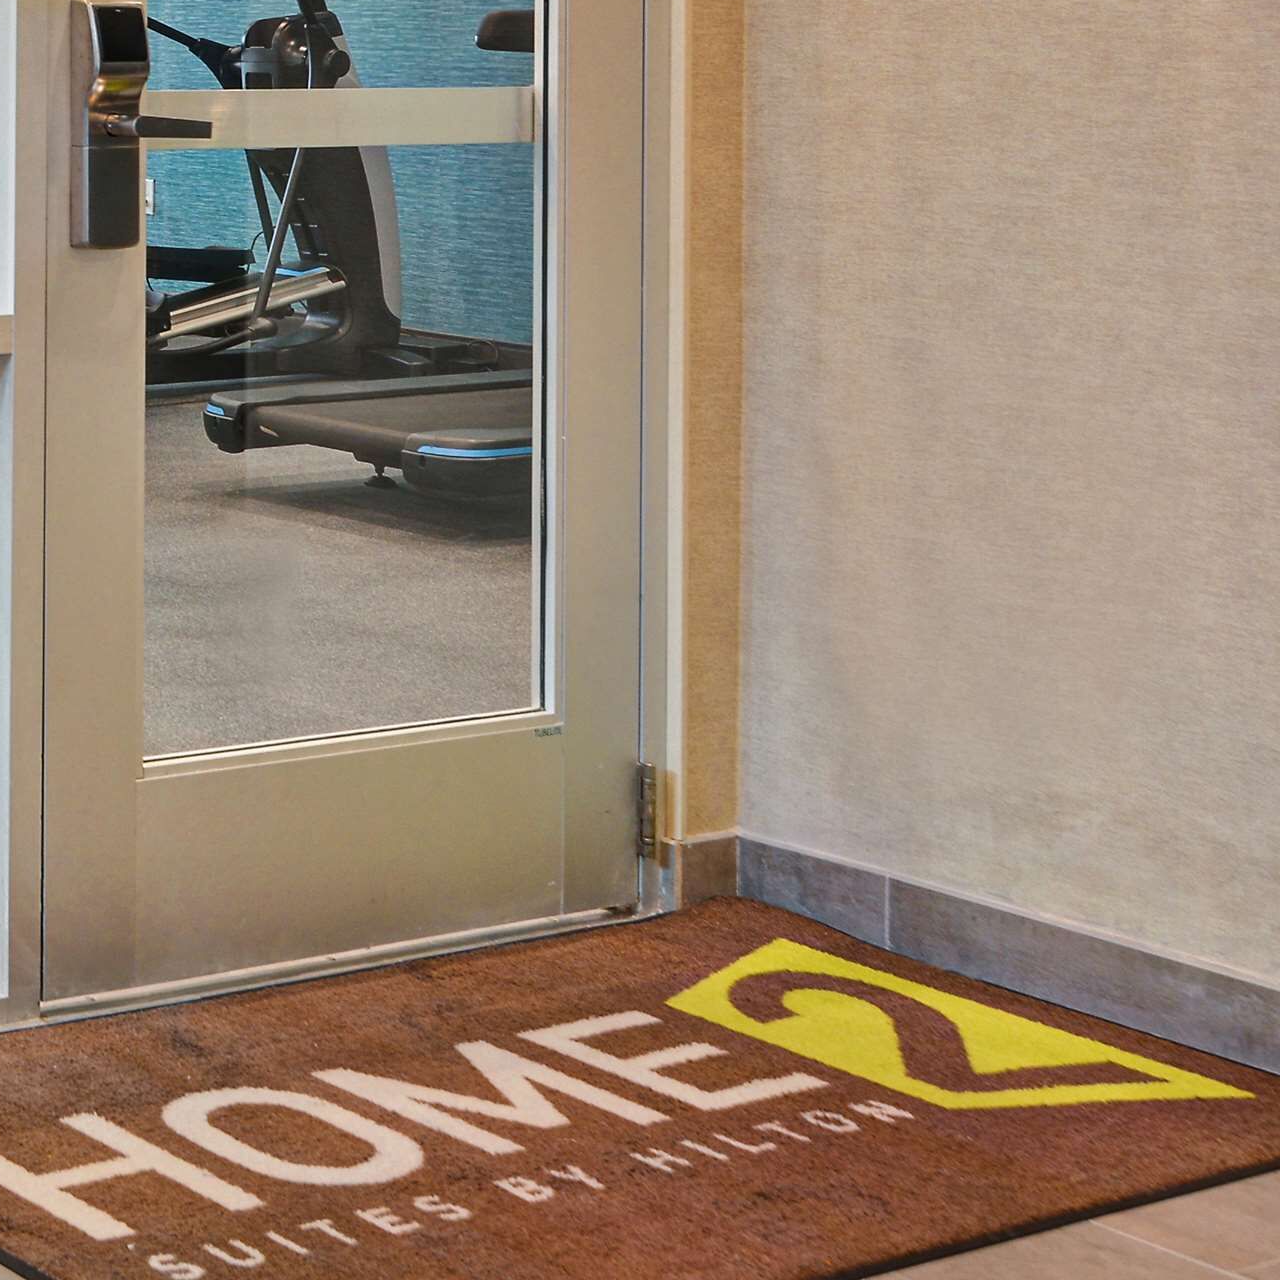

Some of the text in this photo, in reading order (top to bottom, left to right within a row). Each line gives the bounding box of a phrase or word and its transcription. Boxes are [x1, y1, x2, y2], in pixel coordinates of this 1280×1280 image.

[725, 969, 1172, 1093] 2
[148, 1099, 918, 1280] SUITES BY HILTON
